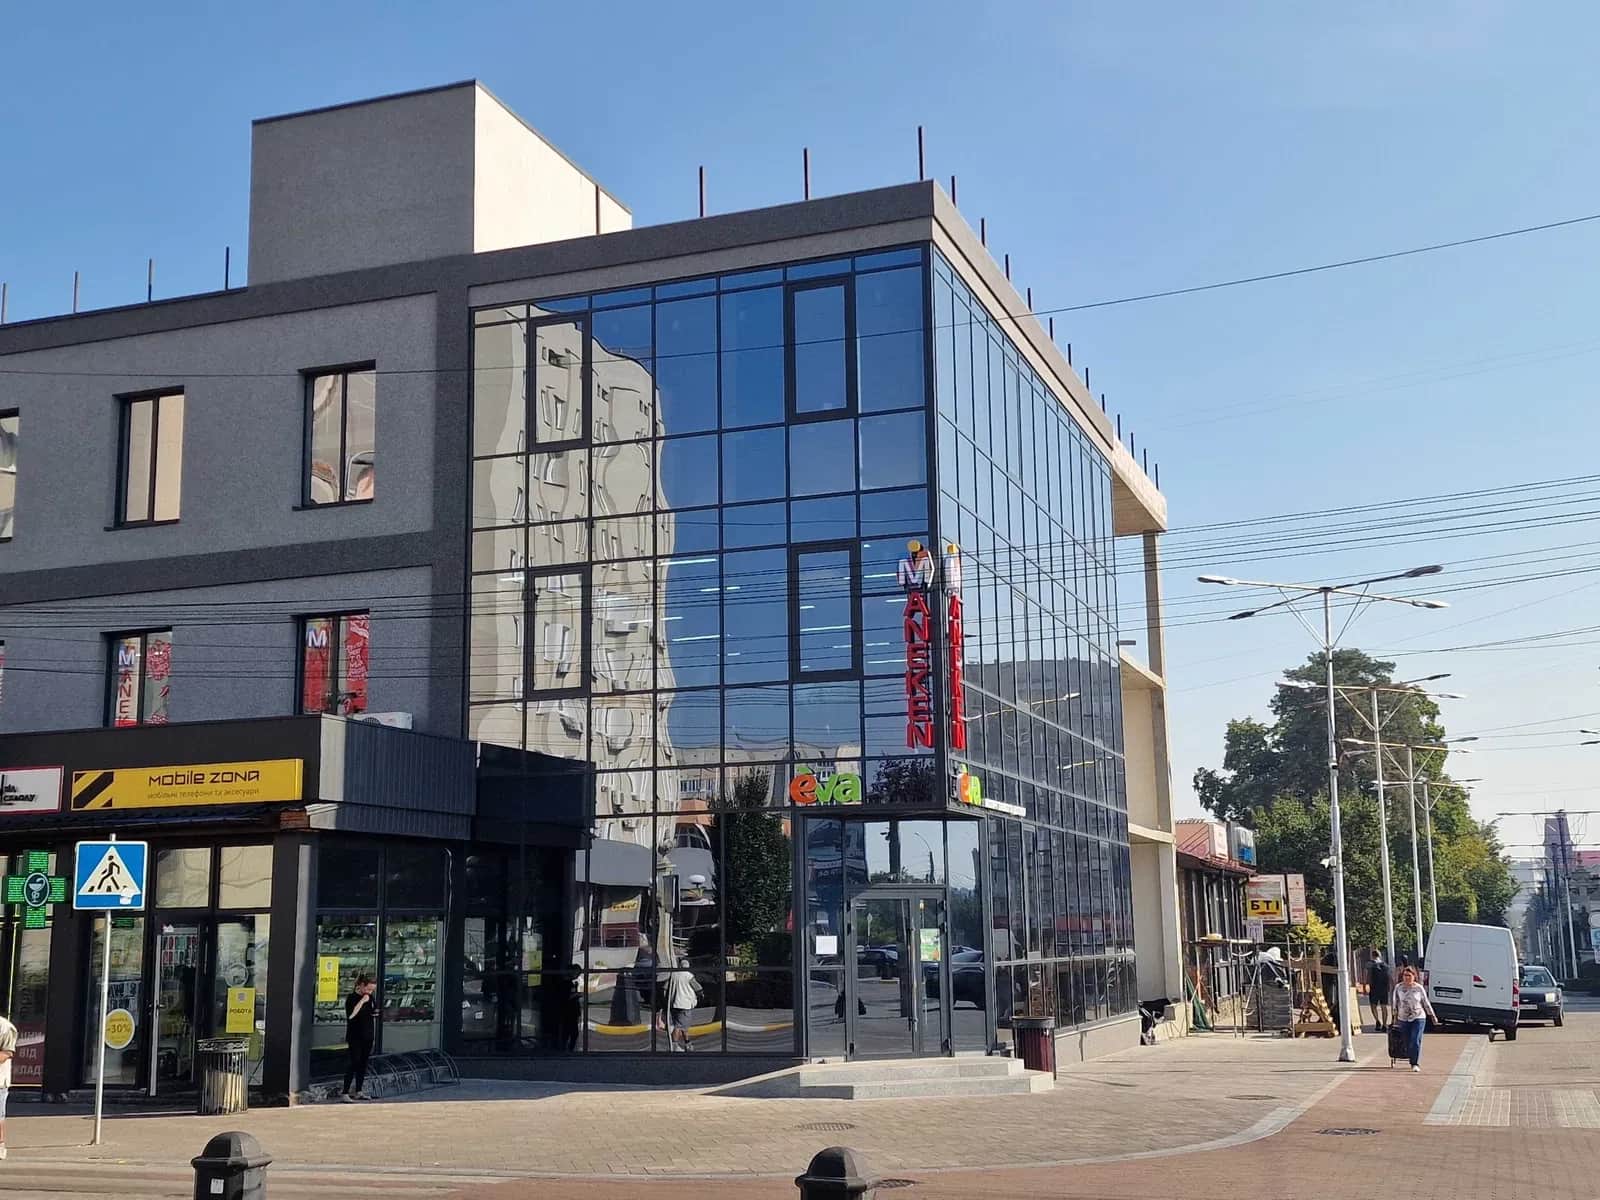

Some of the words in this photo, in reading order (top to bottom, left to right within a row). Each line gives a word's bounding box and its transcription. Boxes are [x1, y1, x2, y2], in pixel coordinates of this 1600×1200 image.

[897, 552, 934, 749] MANEKEN
[789, 770, 861, 804] eva
[1250, 900, 1280, 912] БТІ
